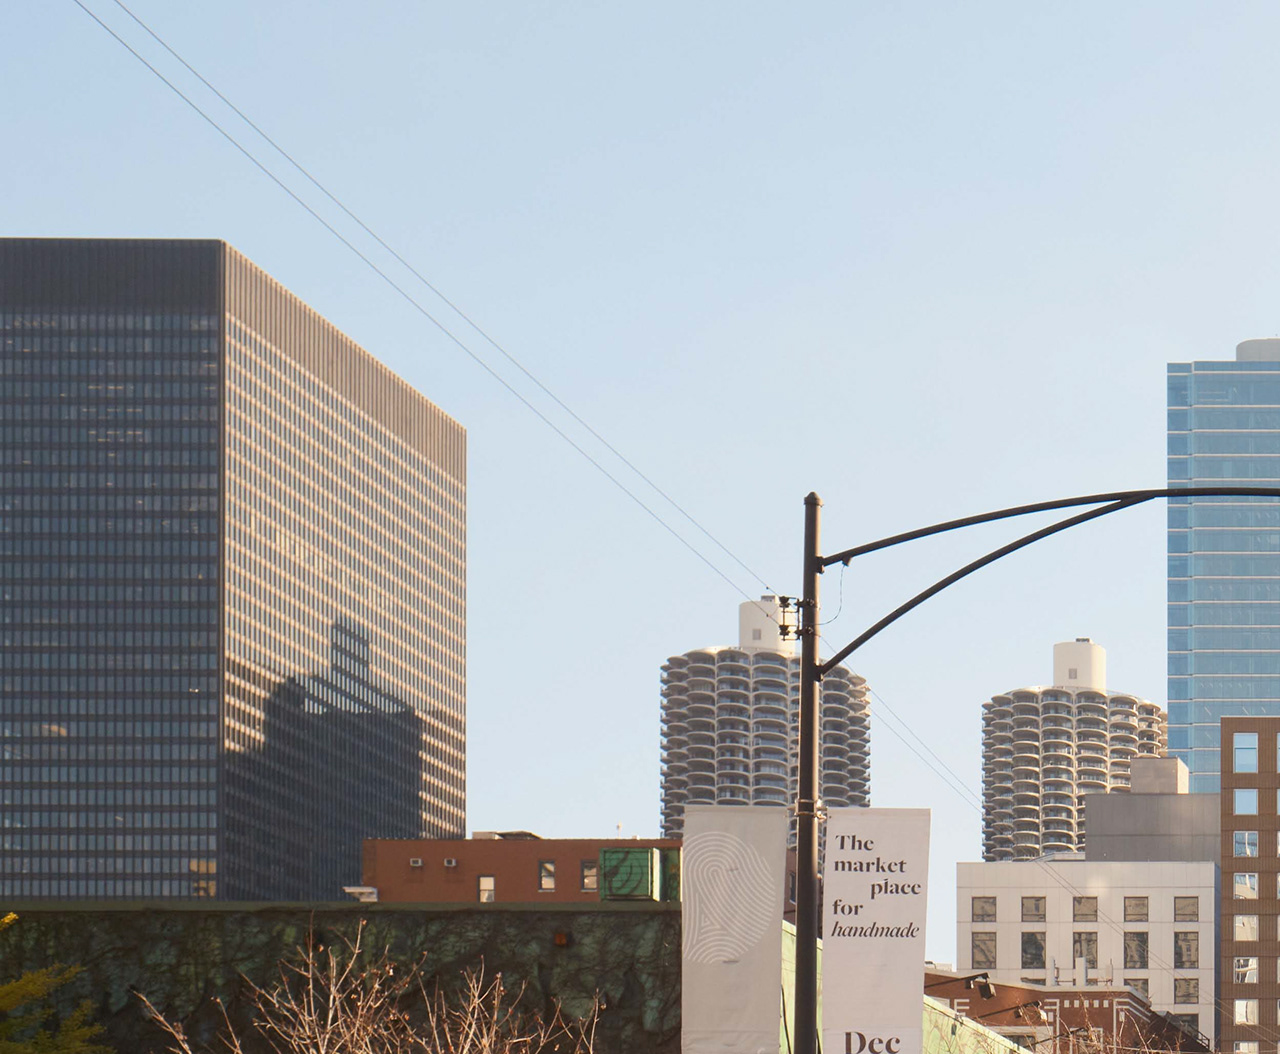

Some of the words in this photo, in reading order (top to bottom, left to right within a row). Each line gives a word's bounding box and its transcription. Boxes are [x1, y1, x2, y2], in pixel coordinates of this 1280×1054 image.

[835, 835, 874, 851] The
[834, 857, 907, 873] market
[870, 879, 921, 899] place
[832, 899, 864, 915] for
[831, 921, 919, 938] handmade
[844, 1031, 900, 1054] Dec
